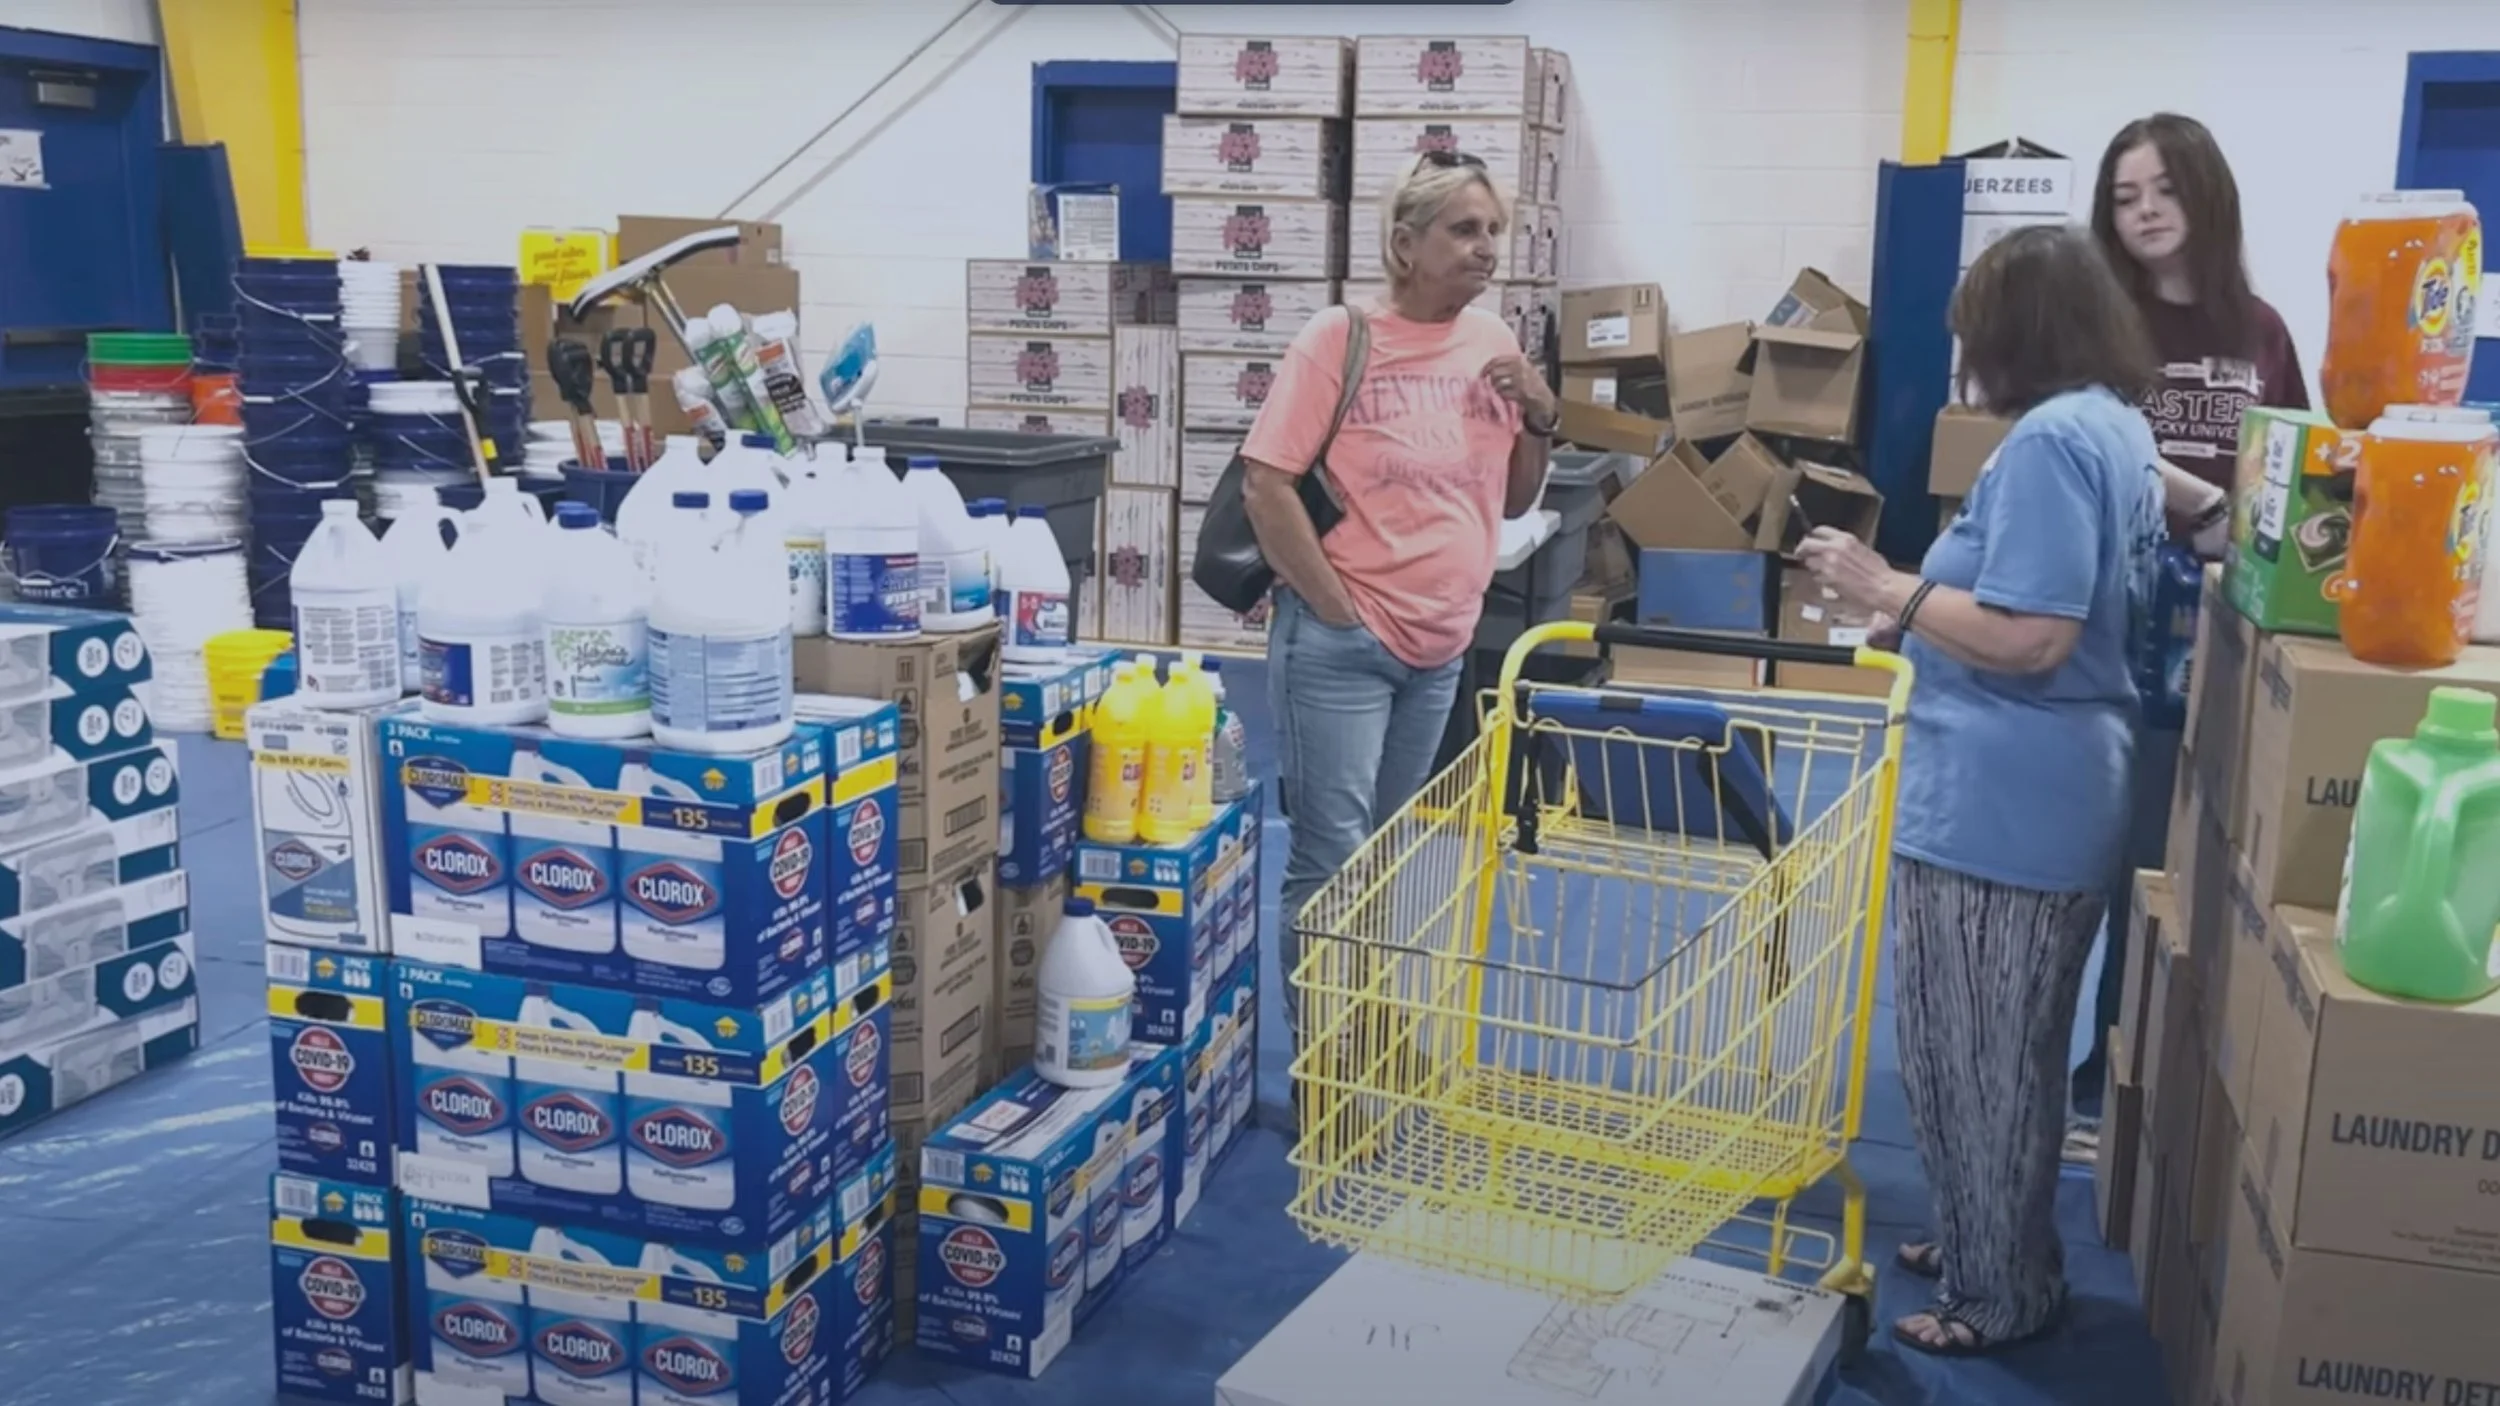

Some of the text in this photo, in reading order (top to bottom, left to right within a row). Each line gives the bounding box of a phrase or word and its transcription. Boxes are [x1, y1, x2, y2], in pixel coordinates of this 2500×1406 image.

[1963, 177, 2053, 194] JERZEES
[2142, 387, 2257, 423] ASTER
[387, 724, 431, 741] 3 PACK
[673, 807, 709, 829] 135
[426, 847, 489, 878] CLOROX
[530, 862, 595, 892] CLOROX
[638, 875, 705, 907] CLOROX
[408, 967, 443, 984] PACK
[295, 1047, 351, 1072] COVID-19
[683, 1053, 720, 1077] 135
[430, 1089, 492, 1120] CLOROX
[534, 1106, 600, 1136] CLOROX
[644, 1120, 713, 1151] CLOROX
[2331, 1112, 2475, 1158] LAUNDRY
[944, 1245, 1001, 1269] COVID-19
[305, 1275, 362, 1299] COVID-19
[693, 1287, 728, 1310] 135
[444, 1312, 507, 1343] CLOROX
[547, 1332, 612, 1362] CLOROX
[655, 1347, 721, 1382] CLOROX
[2298, 1356, 2434, 1403] LAUNDRY
